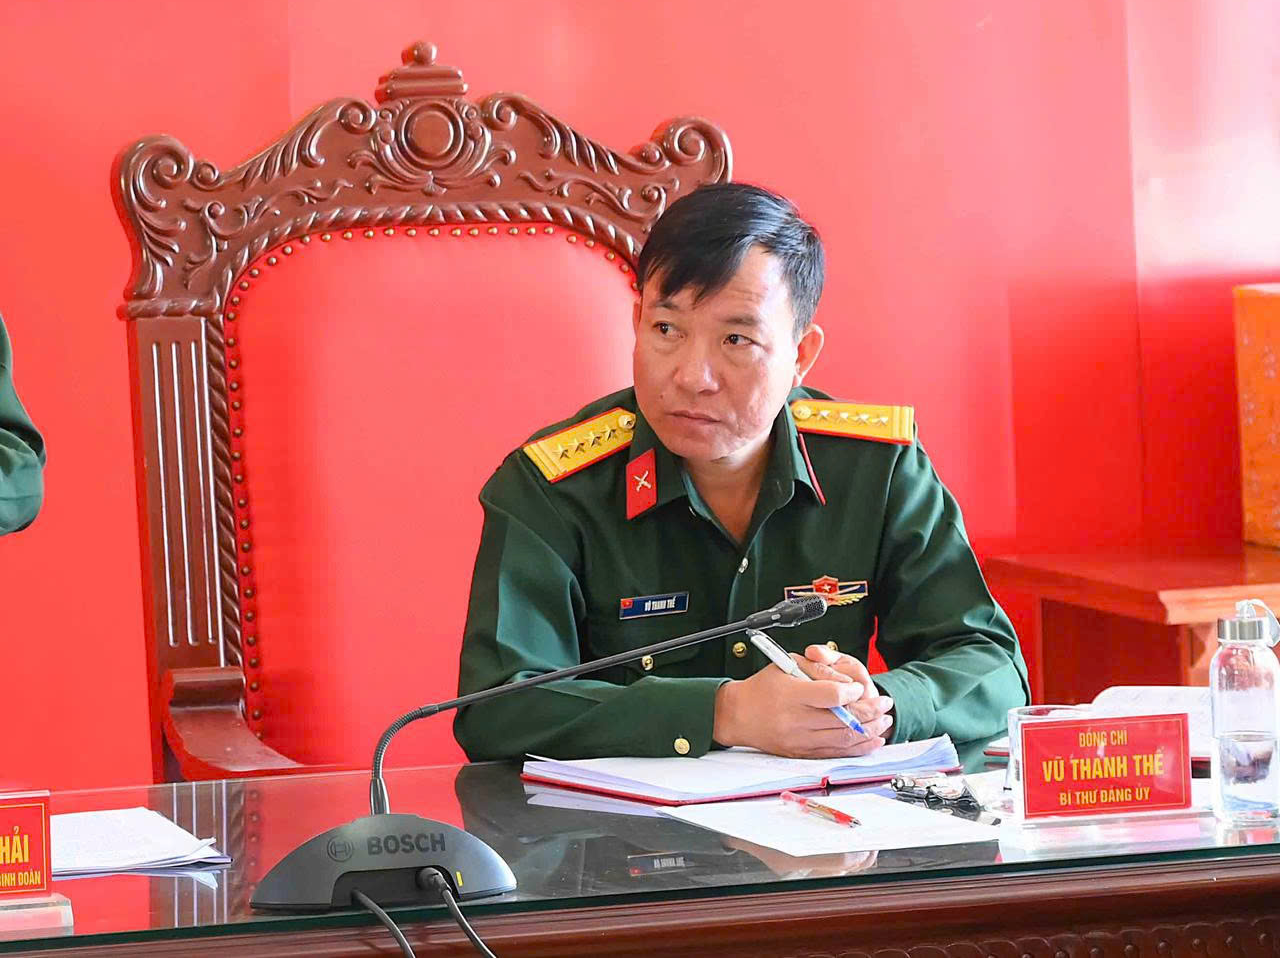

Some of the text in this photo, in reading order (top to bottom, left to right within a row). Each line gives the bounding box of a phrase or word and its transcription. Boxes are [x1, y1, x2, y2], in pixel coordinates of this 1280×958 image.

[1042, 746, 1164, 782] VŨ THANH THẾ
[1075, 788, 1098, 805] THƯ
[367, 833, 446, 856] BOSCH
